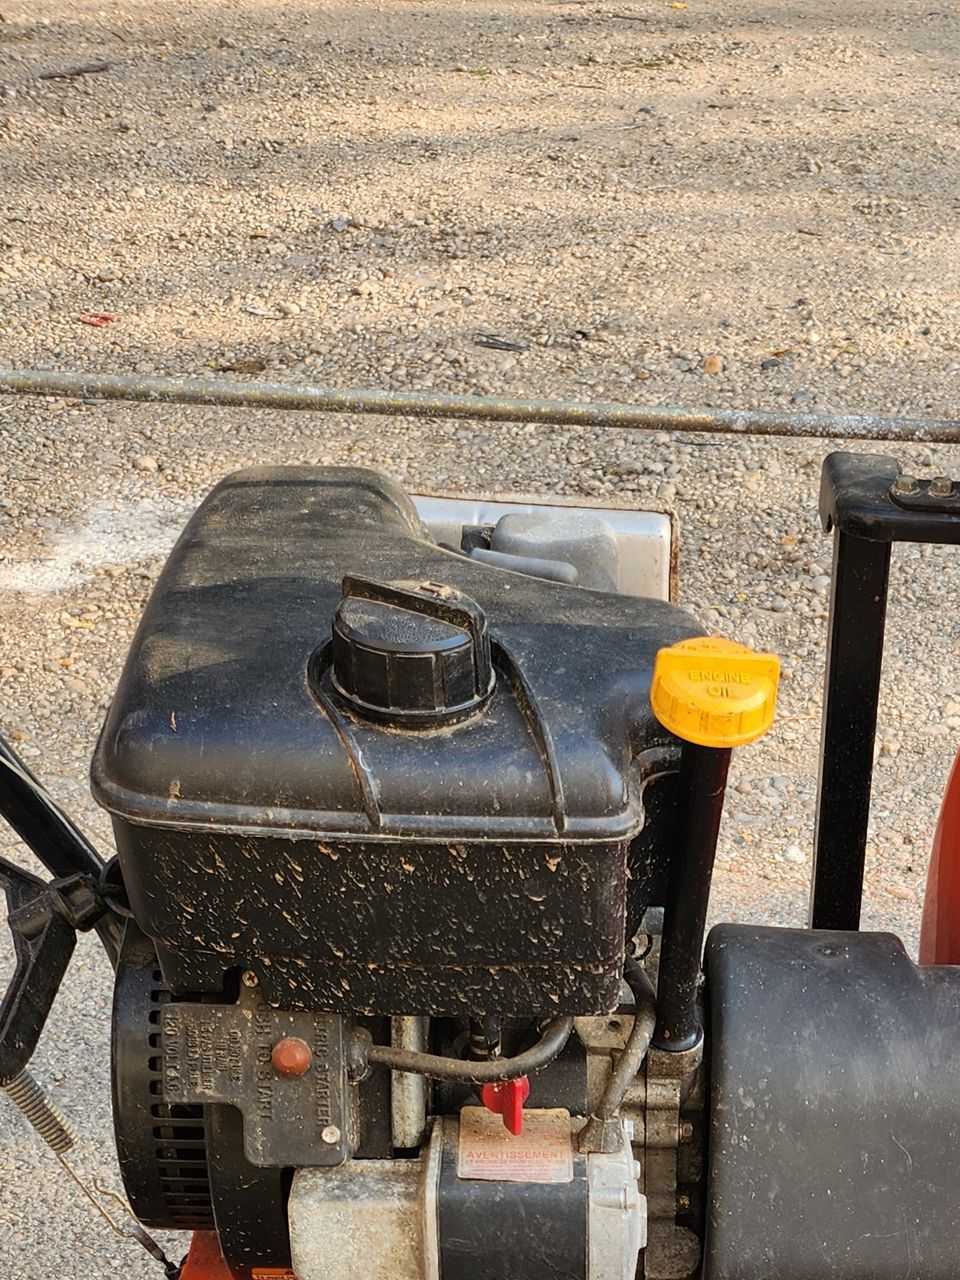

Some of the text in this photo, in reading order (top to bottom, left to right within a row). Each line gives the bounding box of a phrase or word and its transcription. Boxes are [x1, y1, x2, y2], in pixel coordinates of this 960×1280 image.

[688, 669, 752, 684] ENGINE
[707, 685, 737, 698] OIL
[163, 1015, 180, 1036] 120
[164, 1041, 180, 1070] VOLT
[257, 1044, 273, 1062] TO
[257, 1070, 274, 1120] START
[315, 1063, 331, 1127] STARTER
[466, 1151, 564, 1160] AVERTISSEMENT
